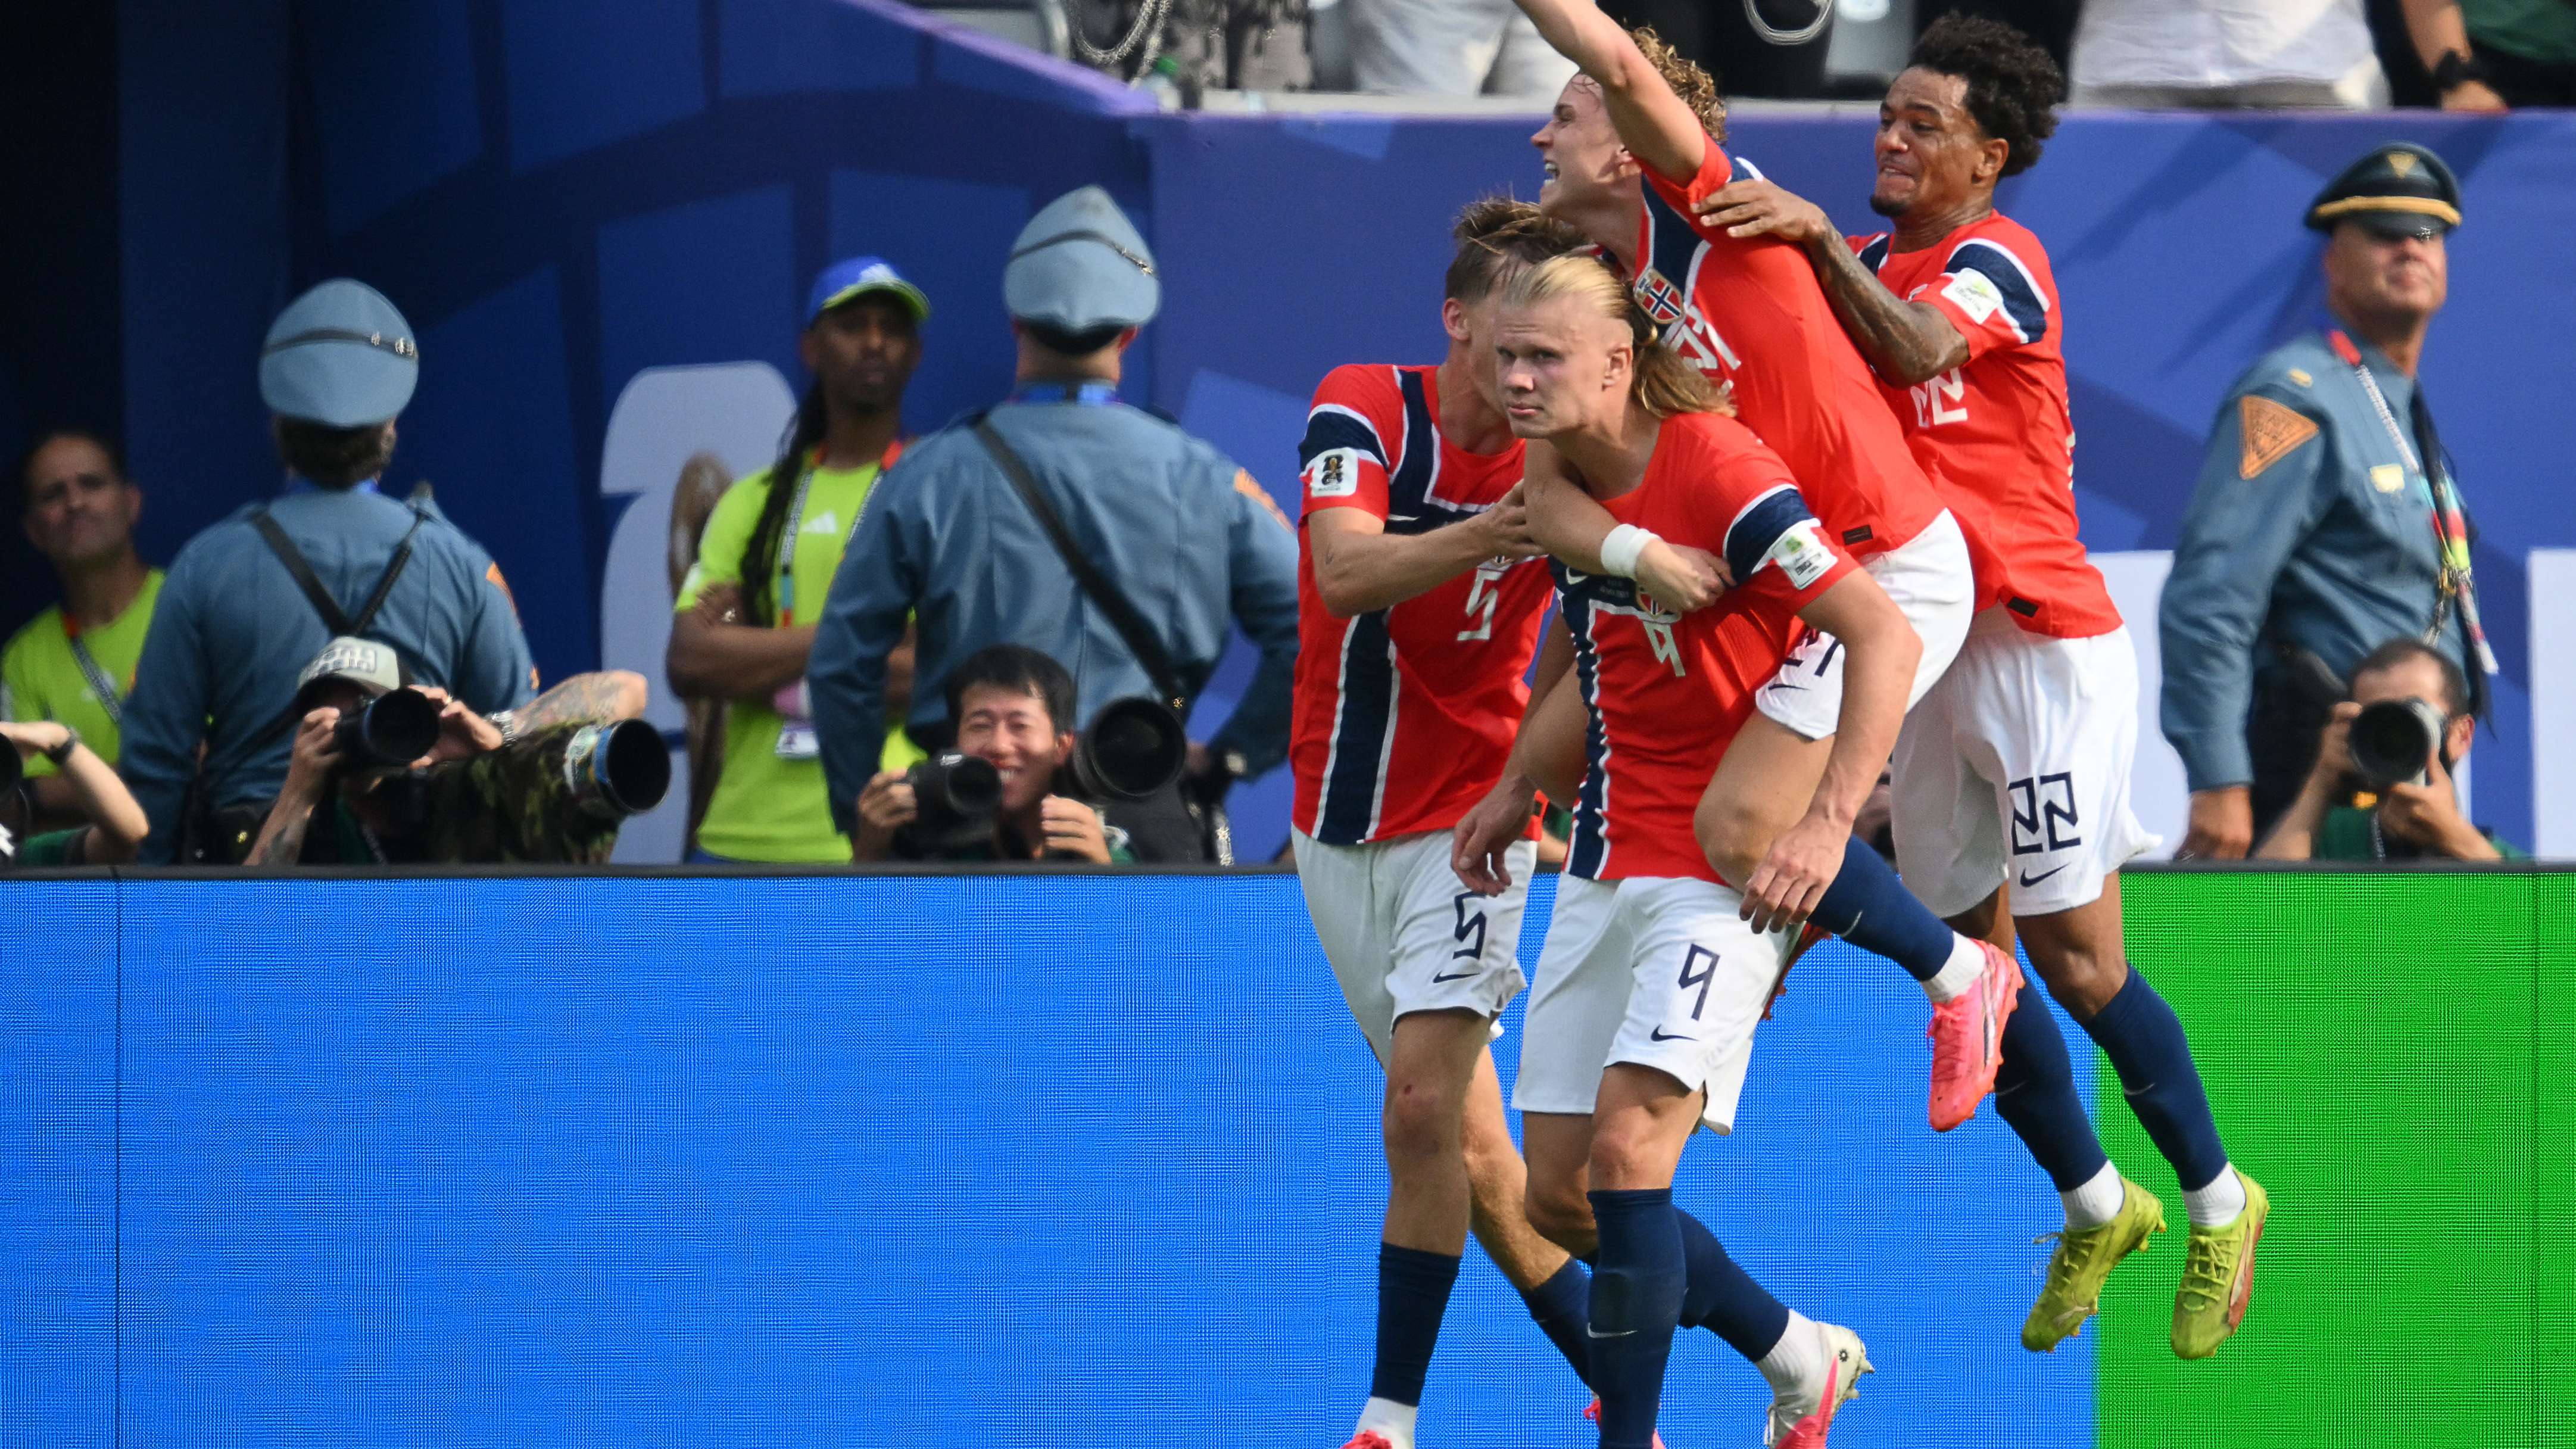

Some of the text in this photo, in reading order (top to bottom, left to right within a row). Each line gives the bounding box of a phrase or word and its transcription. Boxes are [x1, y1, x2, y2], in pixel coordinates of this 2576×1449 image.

[1457, 568, 1504, 641] 5
[1642, 621, 1686, 677] 9
[2007, 772, 2082, 856] 22
[1452, 891, 1487, 960] 5
[1678, 943, 1721, 1021] 9
